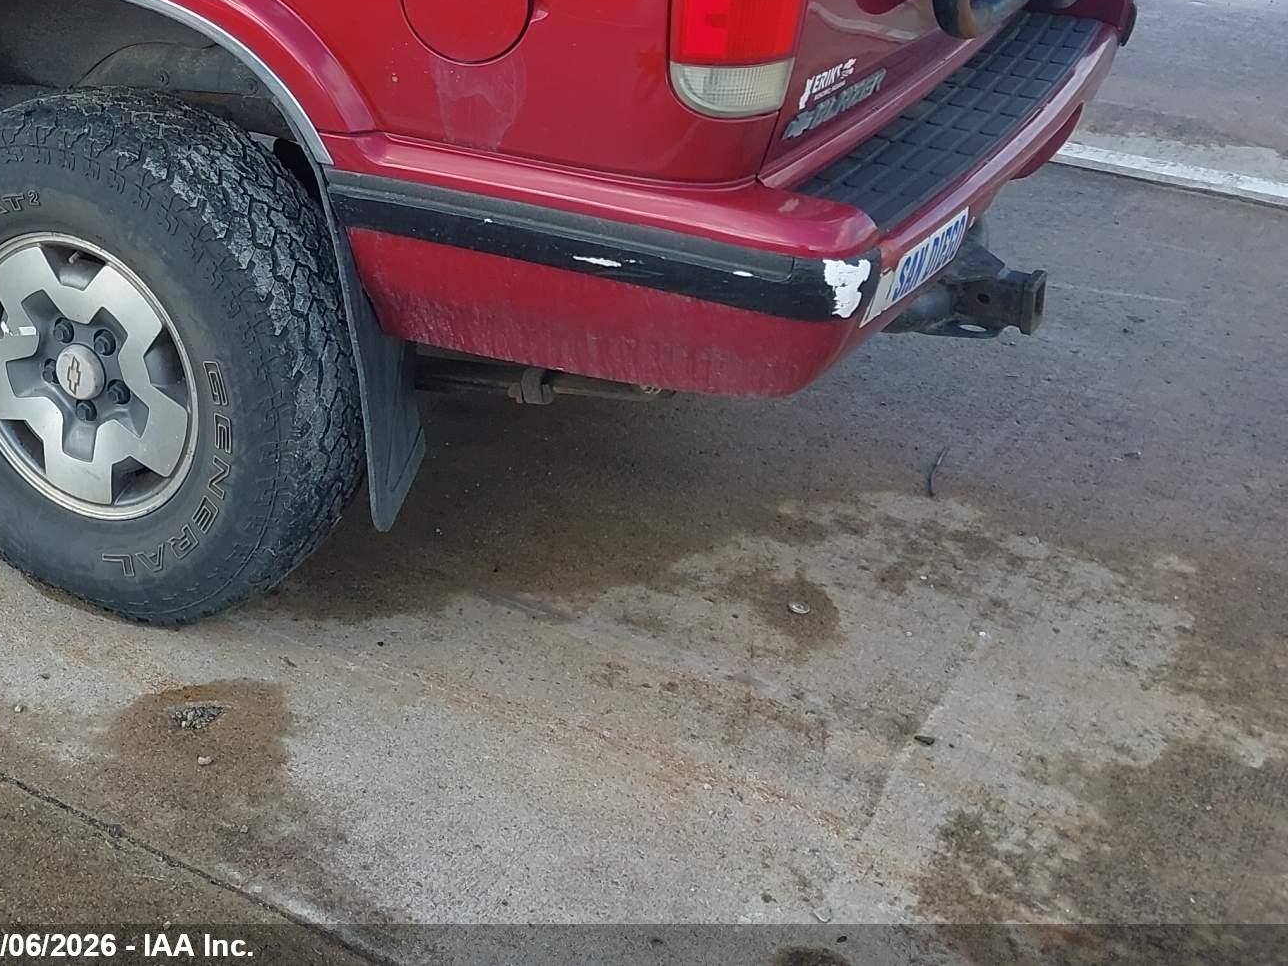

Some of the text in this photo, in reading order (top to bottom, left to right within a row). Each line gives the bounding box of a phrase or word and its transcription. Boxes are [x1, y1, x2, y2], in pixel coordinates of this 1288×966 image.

[892, 214, 966, 302] SAN DIEGO
[101, 359, 234, 579] GENERAL
